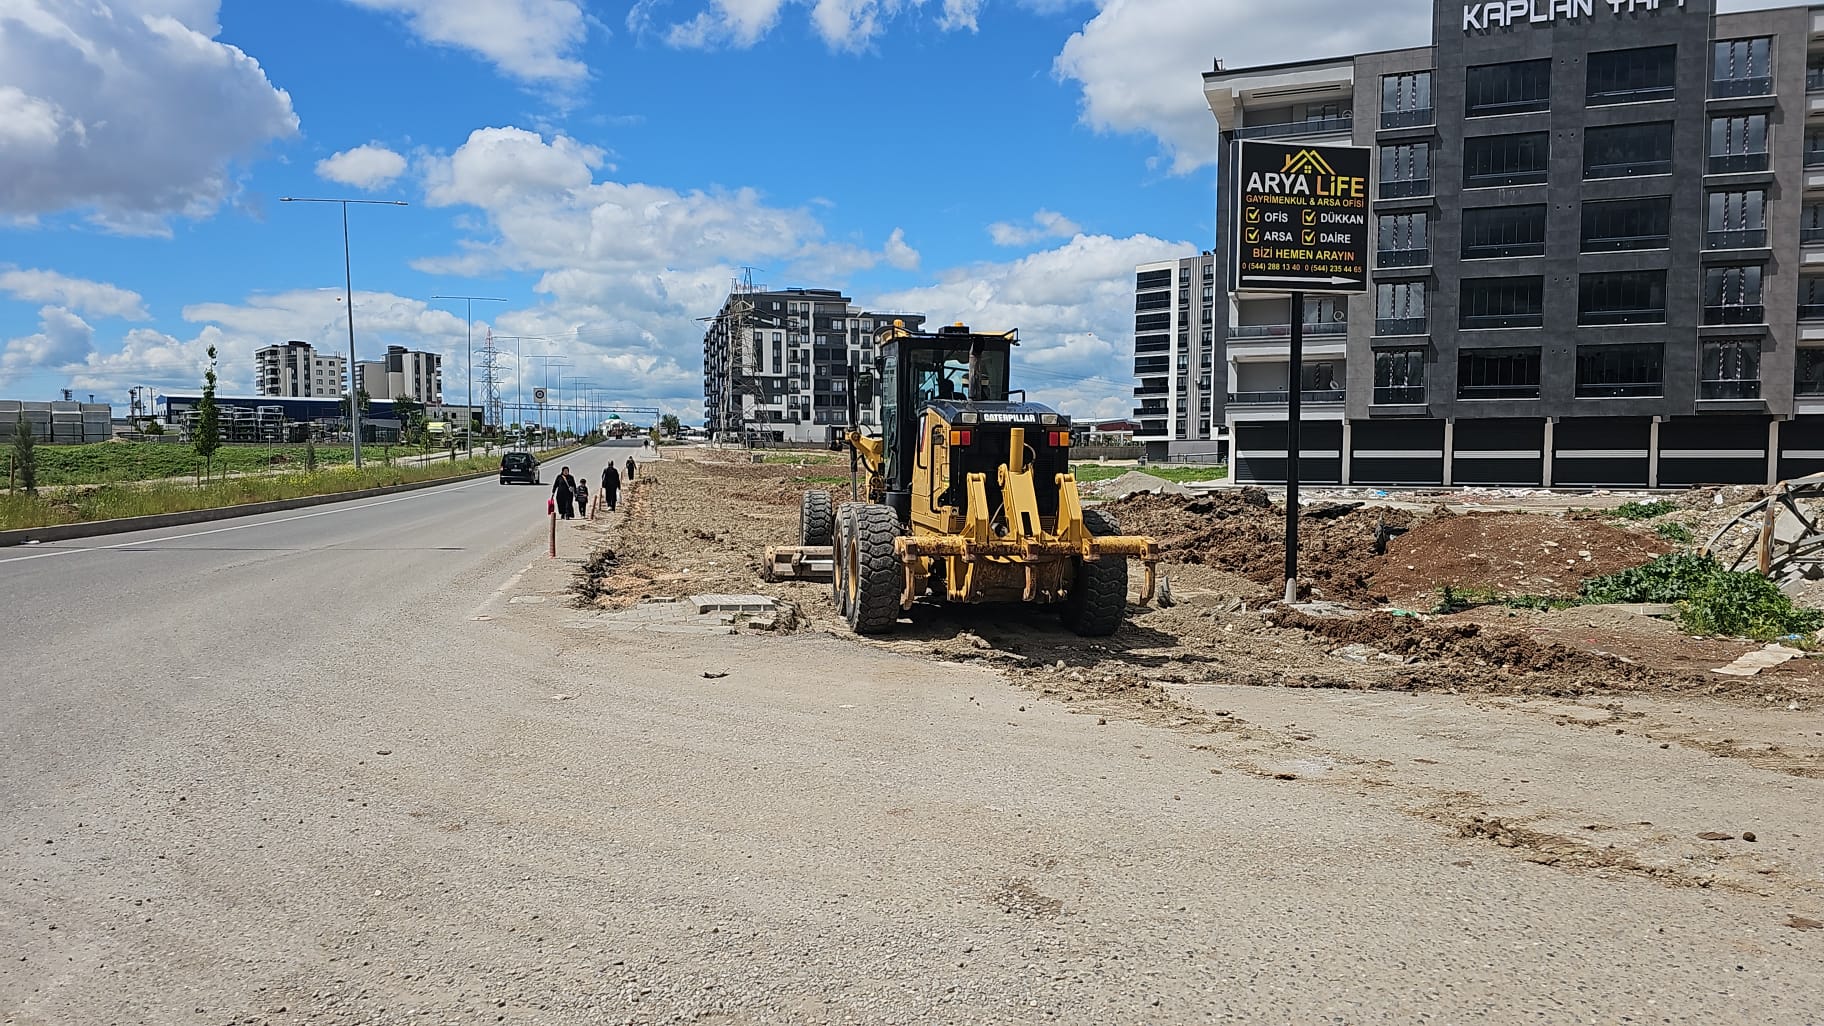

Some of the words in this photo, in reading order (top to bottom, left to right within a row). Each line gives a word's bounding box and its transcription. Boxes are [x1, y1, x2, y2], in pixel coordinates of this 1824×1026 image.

[1463, 0, 1593, 30] KAPLAN
[1246, 172, 1310, 195] ARYA
[1309, 197, 1316, 206] &
[1317, 198, 1341, 207] ARSA
[1264, 210, 1289, 223] OFİS
[1320, 212, 1364, 225] DÜKKAN
[1263, 231, 1293, 242] ARSA
[1320, 232, 1351, 244] DAİRE
[1252, 246, 1273, 259] BİZİ
[1275, 249, 1313, 260] HEMEN
[1315, 250, 1355, 261] ARAYIN
[1248, 263, 1266, 272] (544)
[1282, 263, 1290, 271] 13
[1310, 264, 1328, 273] (544)
[1329, 265, 1342, 273] 235
[1343, 265, 1352, 273] 44
[984, 413, 1035, 423] CATERPILLAR
